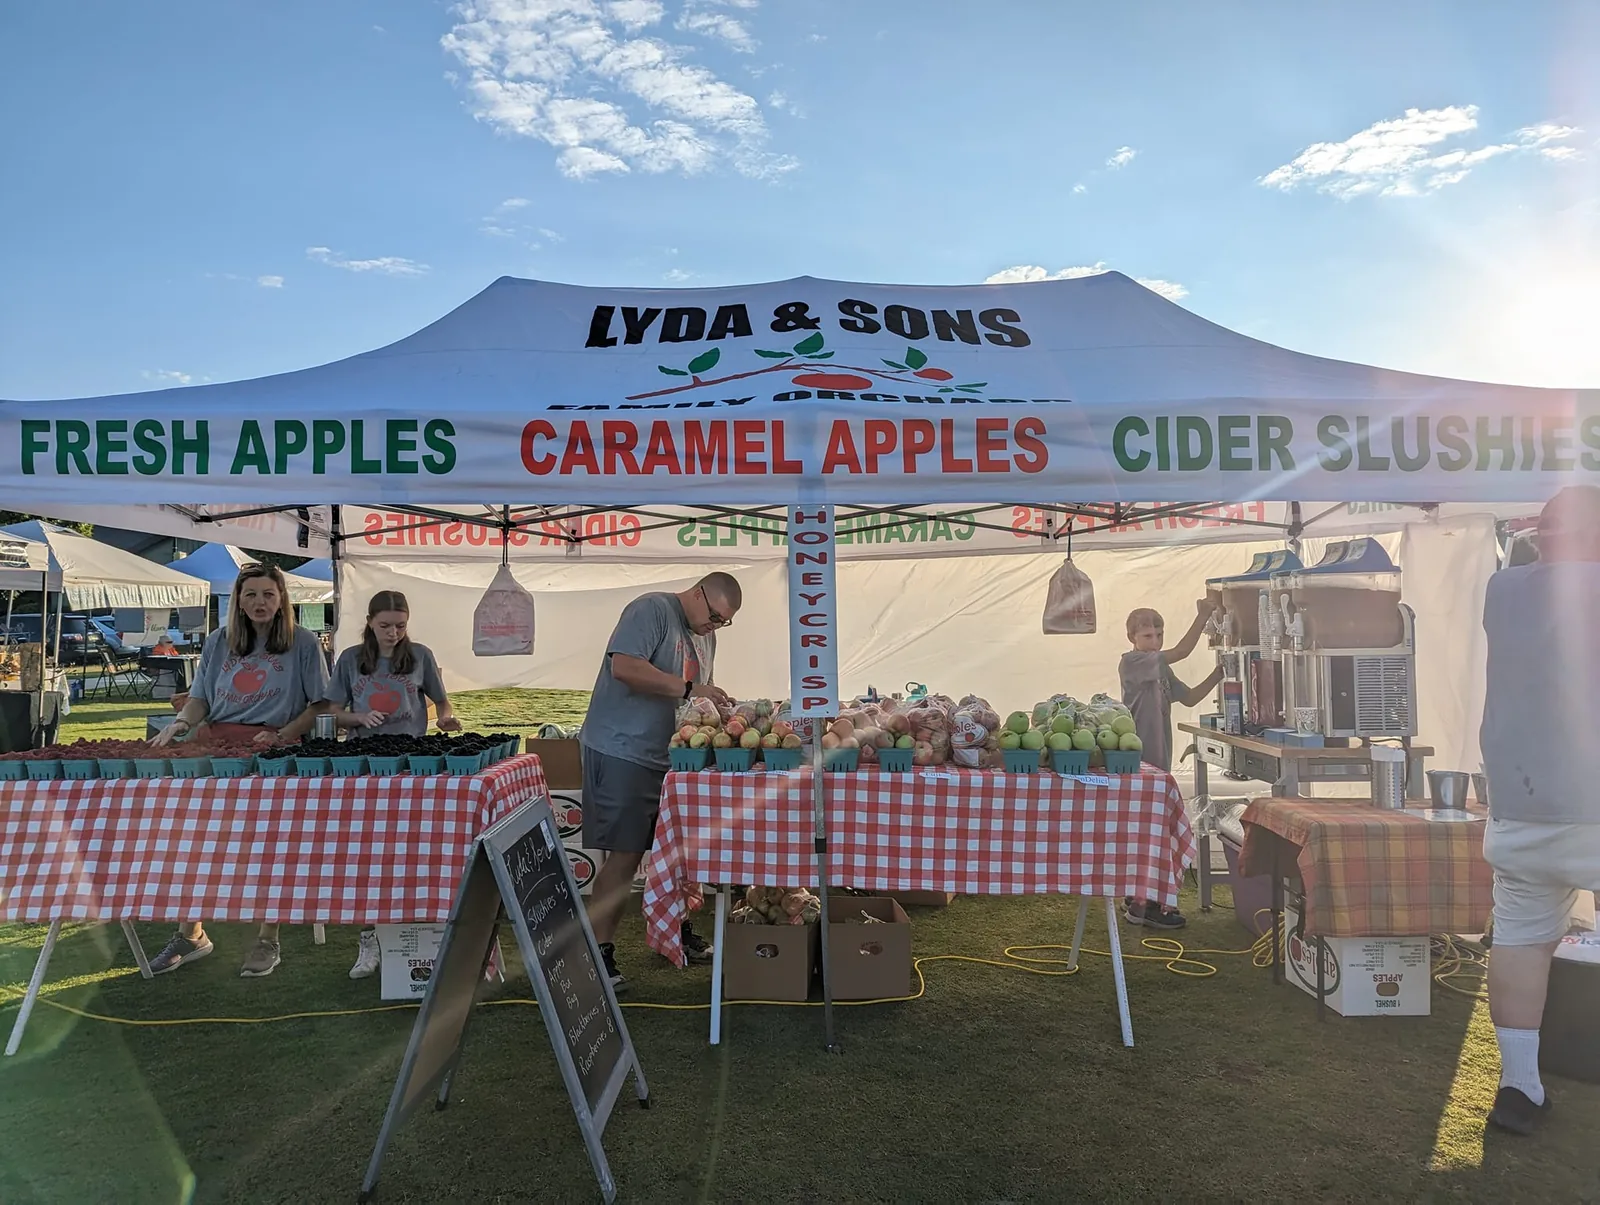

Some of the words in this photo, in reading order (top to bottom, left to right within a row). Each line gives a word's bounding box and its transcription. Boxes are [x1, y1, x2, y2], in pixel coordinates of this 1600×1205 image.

[585, 303, 753, 348] LYDA
[770, 301, 821, 332] &
[838, 298, 1031, 347] SONS
[21, 418, 210, 476] FRESH
[230, 418, 457, 475] APPLES
[520, 419, 803, 475] CARAMEL
[821, 417, 1049, 474] APPLES
[1112, 415, 1297, 473] CIDER
[793, 510, 829, 711] HONEYCRISP
[527, 896, 557, 930] Slushies
[538, 932, 555, 956] Cider
[546, 958, 565, 987] Apples
[560, 978, 572, 994] Box
[1372, 973, 1403, 983] APPLES
[566, 993, 580, 1010] Bag
[1375, 999, 1397, 1008] BUSHEL
[568, 1006, 600, 1047] Blackberries
[578, 1030, 607, 1076] Raspberries
[607, 1016, 614, 1033] 8
